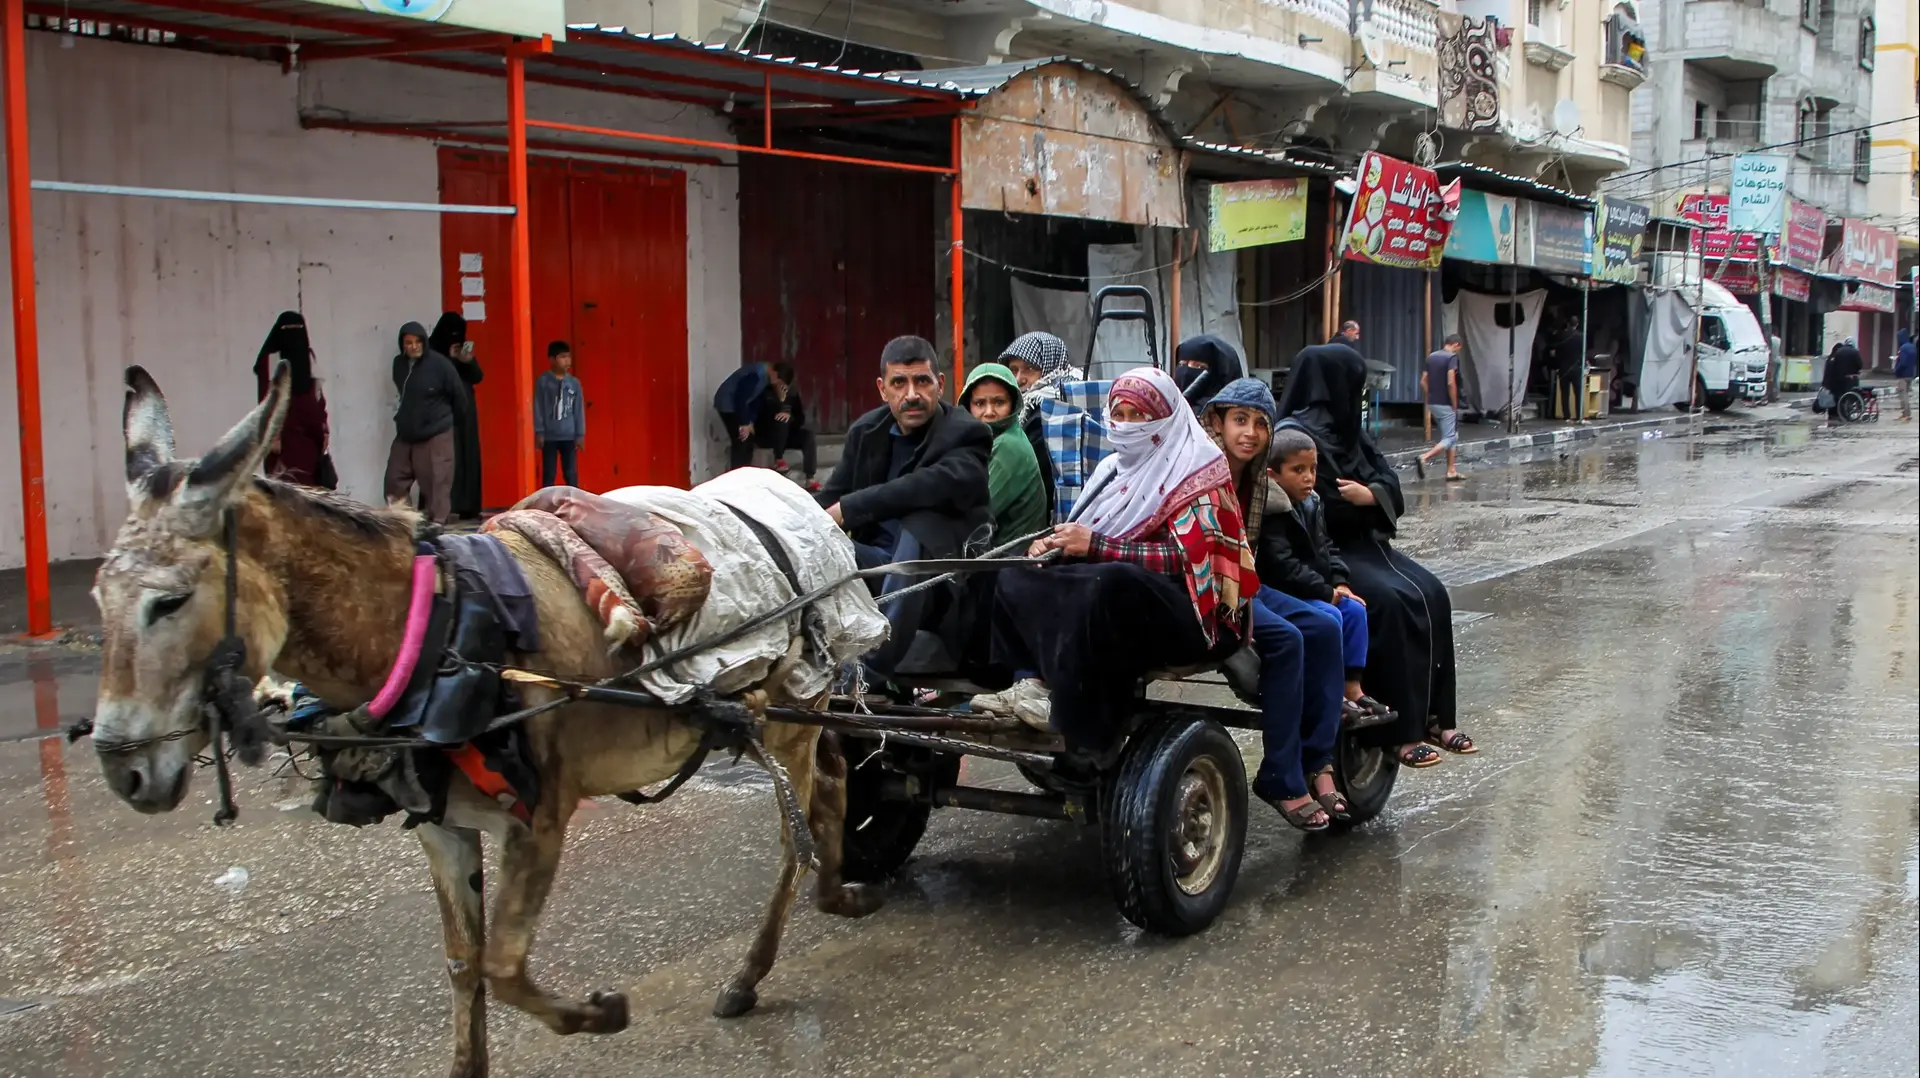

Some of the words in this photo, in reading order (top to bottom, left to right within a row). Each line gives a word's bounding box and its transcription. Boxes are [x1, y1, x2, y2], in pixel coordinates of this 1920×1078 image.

[1741, 161, 1777, 174] مرطبات
[1734, 177, 1784, 191] وجاتوهات
[1390, 170, 1430, 218] الباشا
[1741, 193, 1770, 207] الشام
